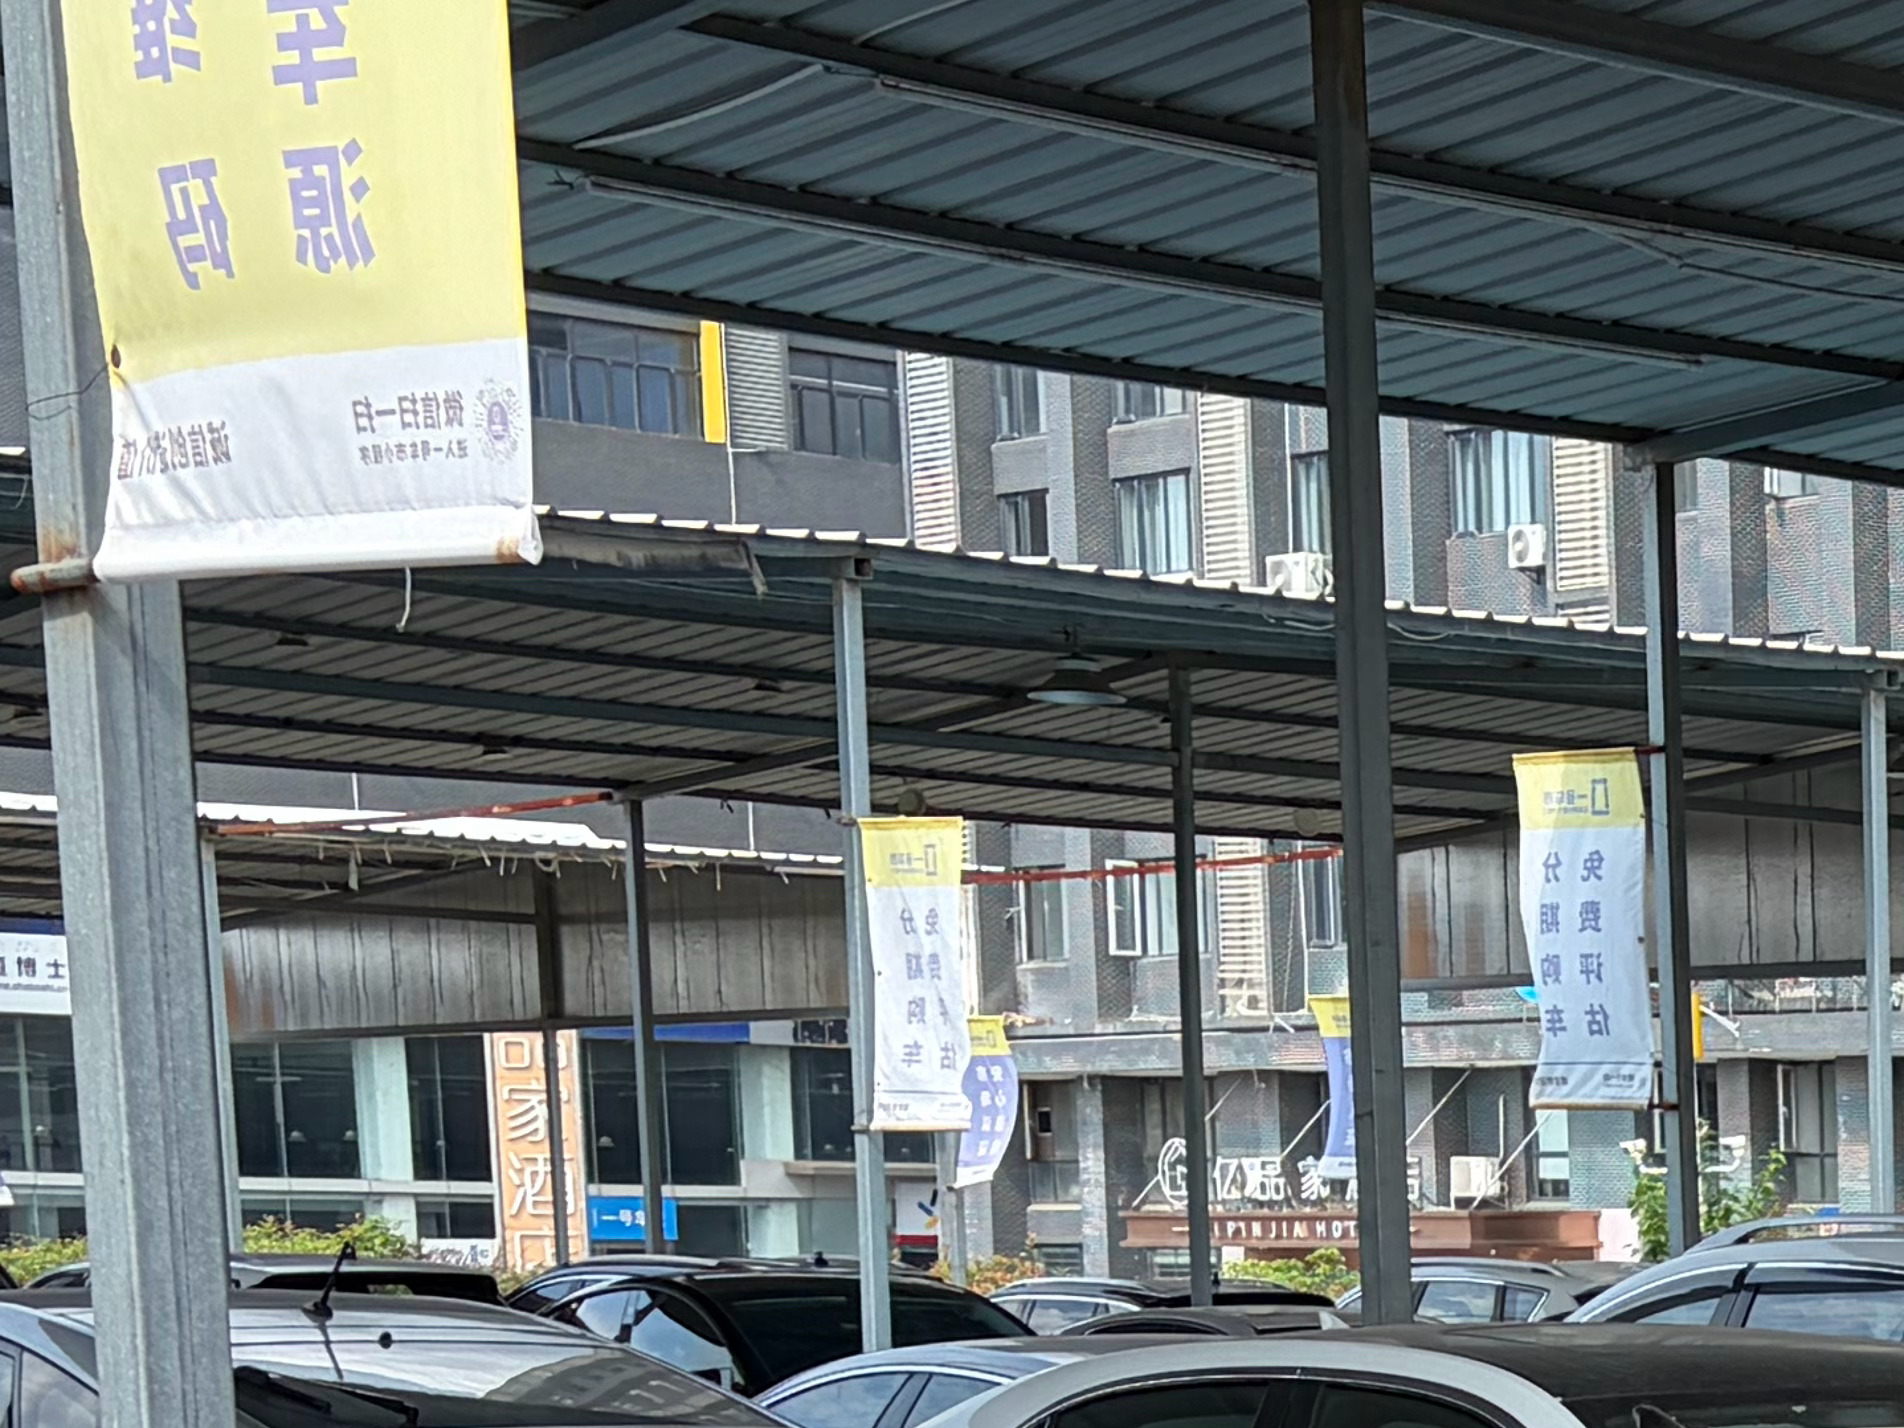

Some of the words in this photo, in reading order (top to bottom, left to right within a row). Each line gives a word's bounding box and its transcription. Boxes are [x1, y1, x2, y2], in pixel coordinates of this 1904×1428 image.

[0, 956, 66, 979] 博士
[1213, 1220, 1302, 1239] IPINJIA
[1315, 1220, 1358, 1239] HOT
